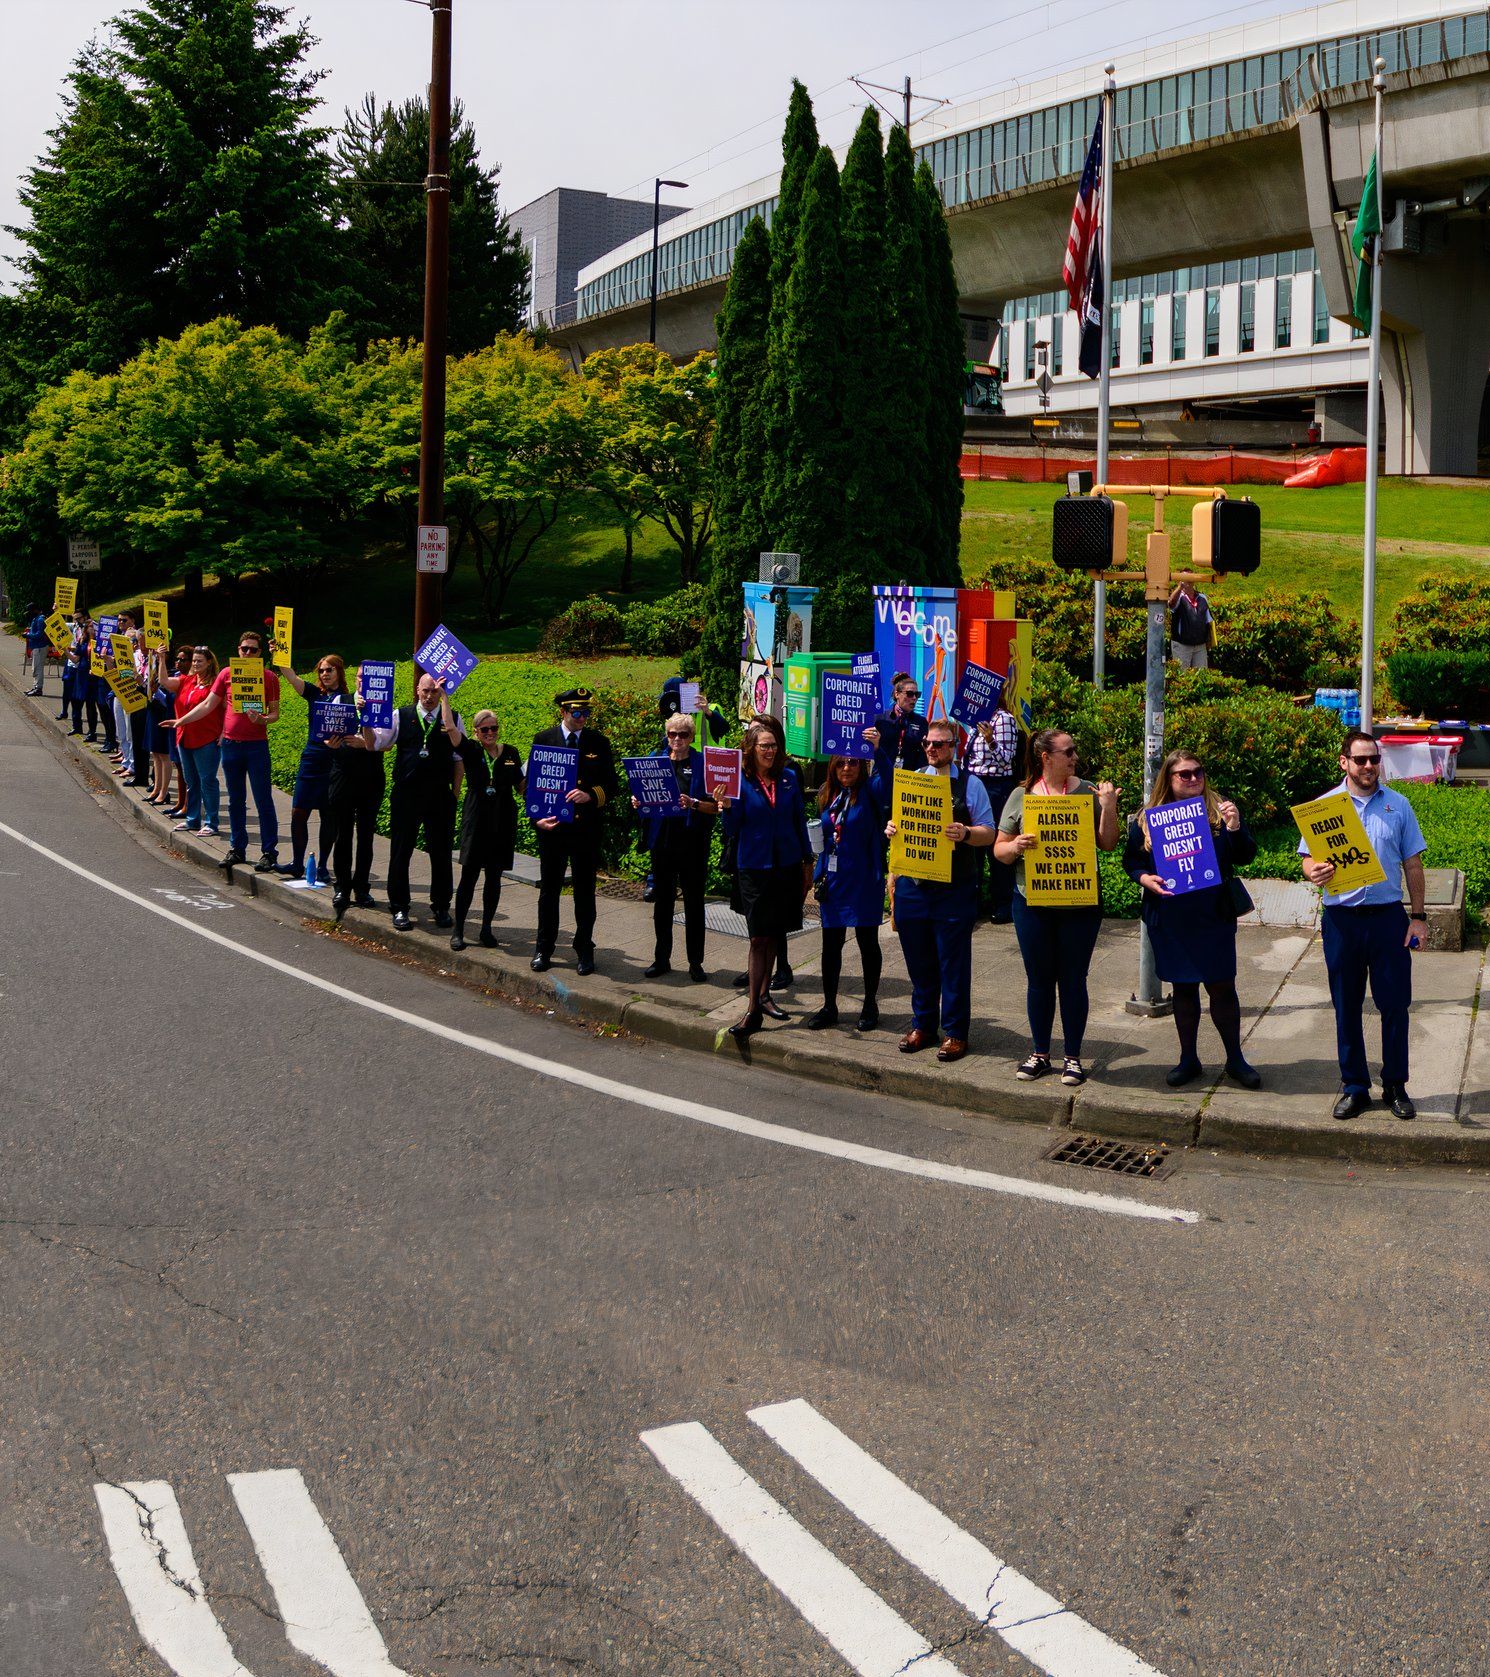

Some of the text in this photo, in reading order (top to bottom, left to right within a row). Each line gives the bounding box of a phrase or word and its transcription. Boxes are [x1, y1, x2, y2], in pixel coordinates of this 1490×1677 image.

[428, 532, 438, 540] NO
[421, 542, 446, 551] PARKING
[873, 586, 958, 652] Welcome
[417, 628, 447, 663] CORPORATE
[430, 643, 448, 664] GREED
[434, 646, 458, 673] DOESN'T
[858, 655, 872, 665] FLIGHT
[364, 666, 393, 676] CORPORATE
[447, 660, 459, 674] FLY
[853, 664, 879, 675] ATTENDANTS
[369, 678, 386, 688] GREED
[966, 666, 1002, 690] CORPORATE
[826, 678, 872, 695] CORPORATE
[970, 680, 990, 695] GREED
[836, 694, 862, 708] GREED
[964, 689, 990, 707] DOESN'T
[316, 710, 354, 718] ATTENDANTS
[372, 703, 381, 714] FLY
[967, 703, 979, 714] FLY
[832, 708, 866, 724] DOESN'T
[321, 724, 347, 733] LIVES!
[842, 726, 855, 739] FLY
[534, 750, 576, 765] CORPORATE
[541, 765, 565, 777] GREED
[635, 760, 659, 769] FLIGHT
[709, 764, 736, 773] Contract
[629, 769, 672, 778] ATTENDANTS
[536, 778, 568, 791] DOESN'T
[641, 779, 666, 790] SAVE
[544, 793, 557, 804] FLY
[642, 791, 672, 803] LIVES!
[901, 792, 943, 807] DON'T LIKE
[902, 806, 941, 821] WORKING
[1038, 814, 1079, 825] ALASKA
[1150, 803, 1203, 828] CORPORATE
[901, 820, 942, 835] FOR FREE?
[1164, 821, 1195, 840] GREED
[1310, 815, 1345, 835] READY
[904, 834, 937, 848] NEITHER
[1040, 830, 1077, 842] MAKES
[1326, 833, 1348, 848] FOR
[906, 848, 916, 858] DO
[1045, 846, 1075, 859] $$$$
[1163, 836, 1202, 858] DOESN'T
[1035, 863, 1085, 874] WE CAN'T
[1178, 856, 1194, 872] FLY
[1032, 879, 1091, 890] MAKE RENT
